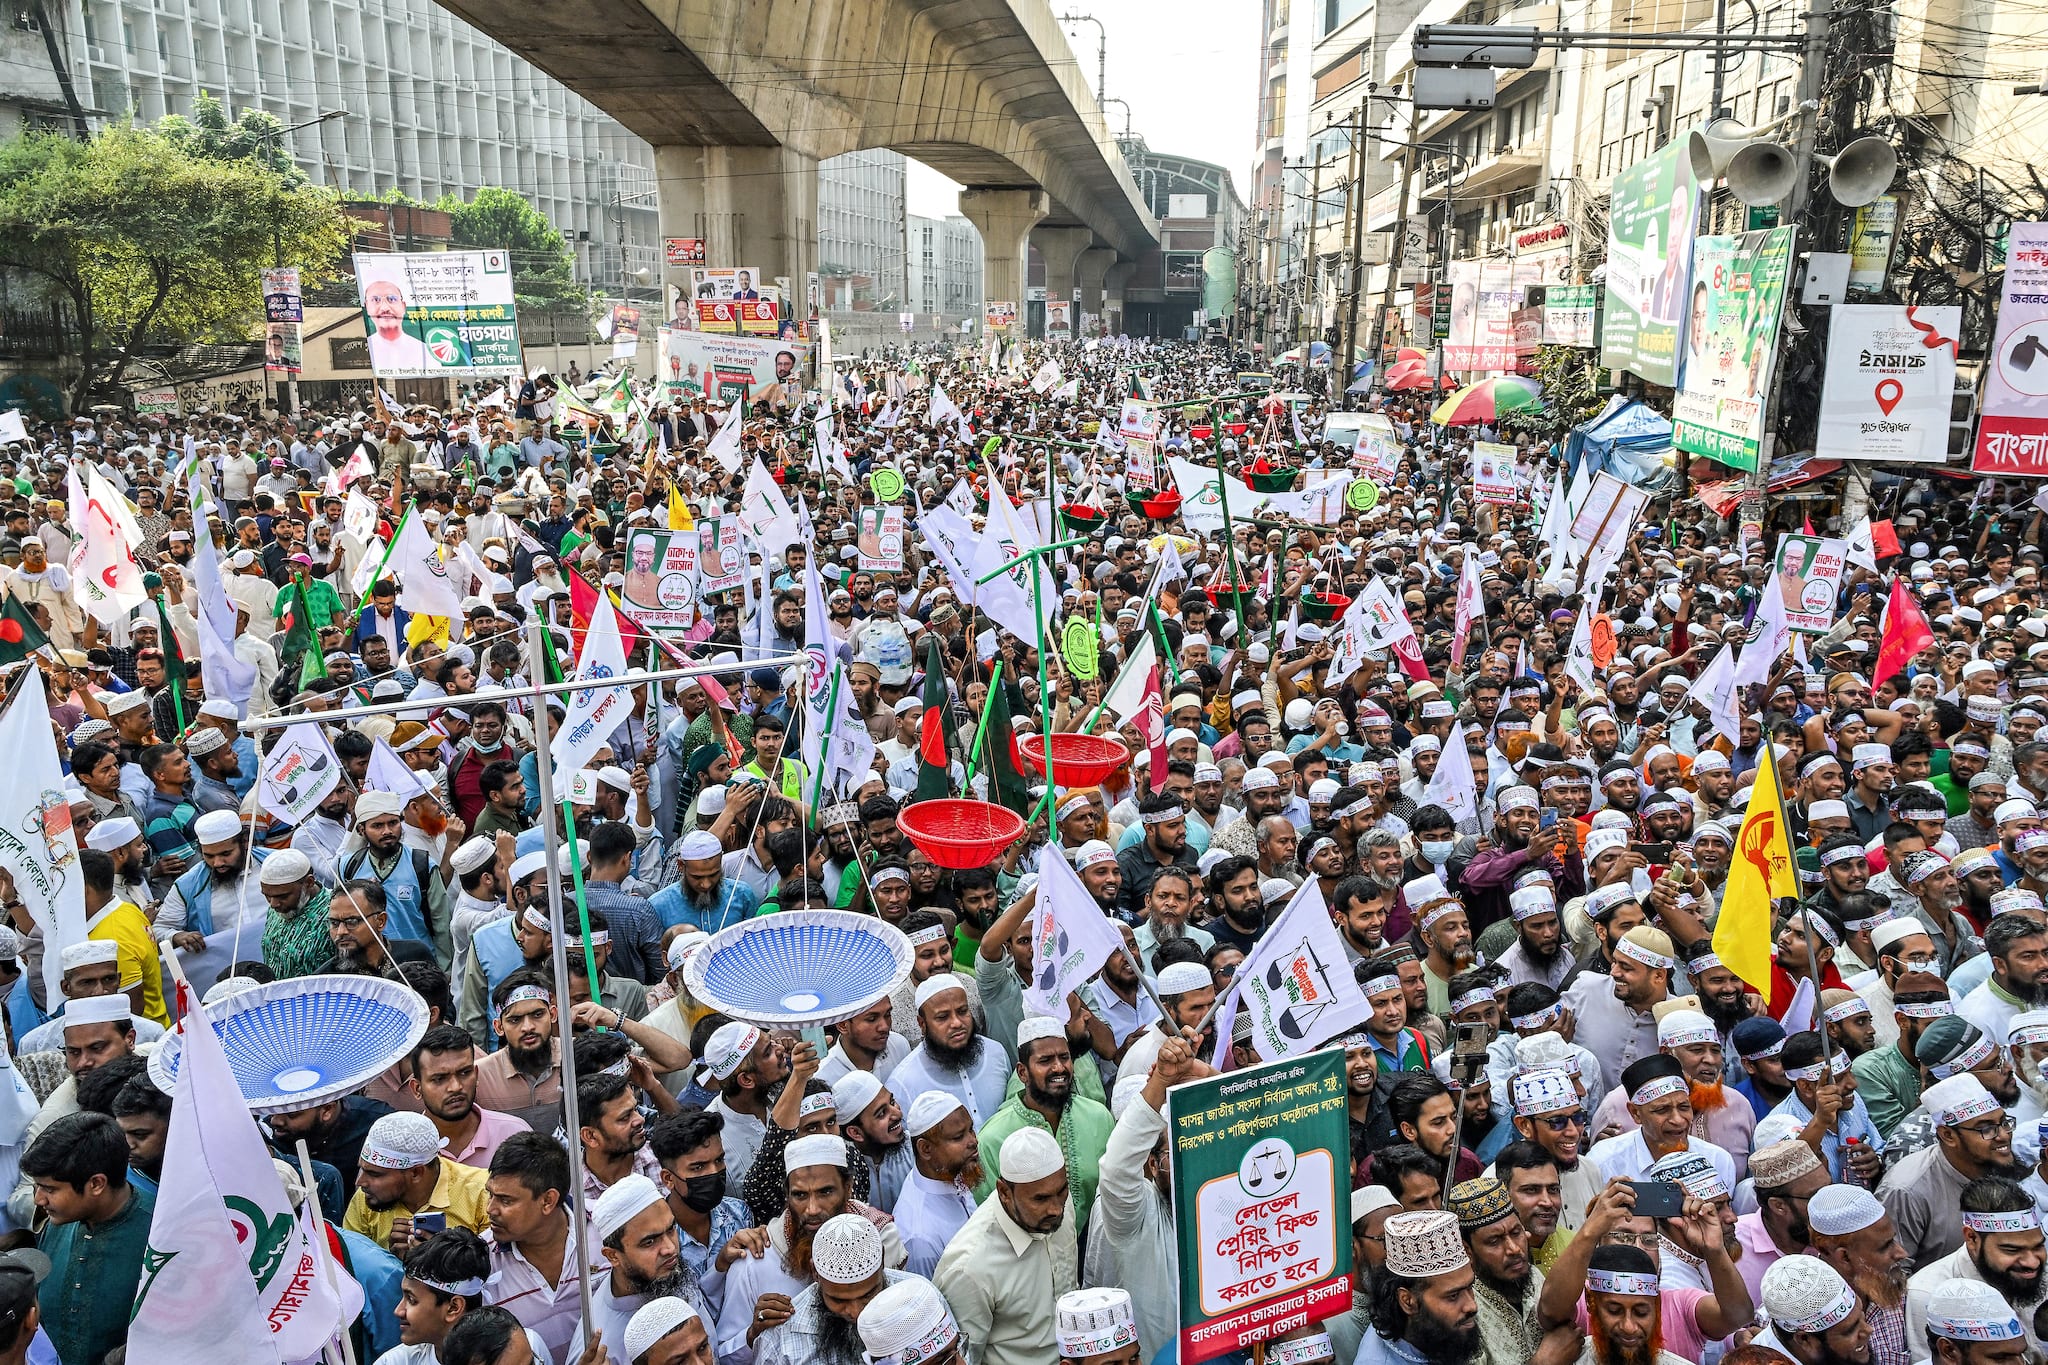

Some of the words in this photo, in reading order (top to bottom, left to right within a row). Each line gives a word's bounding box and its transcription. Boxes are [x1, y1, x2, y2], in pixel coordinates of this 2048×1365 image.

[443, 266, 475, 277] আসনে
[410, 293, 432, 303] সংসদ
[435, 292, 458, 302] সদস্য
[458, 326, 514, 343] হাতপাখা
[472, 355, 494, 365] ভোট
[498, 354, 517, 364] দিন
[1220, 1077, 1258, 1097] বিসমিল্লাহির
[1259, 1071, 1287, 1089] রহমানির
[1289, 1067, 1305, 1083] রহিম
[1179, 1113, 1205, 1128] আসন্ন
[1207, 1106, 1234, 1121] জাতীয়
[1237, 1099, 1262, 1113] সংসদ
[1264, 1089, 1294, 1107] নির্বাচন
[1296, 1083, 1321, 1101] অবাধ,
[1179, 1132, 1215, 1153] নিরপেক্ষ
[1217, 1130, 1225, 1141] ও
[1227, 1114, 1280, 1139] শান্তিপূর্ণভাবে
[1281, 1104, 1320, 1126] অনুষ্ঠানের
[1235, 1191, 1301, 1226] লেভেল
[1973, 1215, 2022, 1231] জামায়াতে
[1216, 1226, 1267, 1258] প্লেয়িং
[1276, 1208, 1320, 1239] ফিল্ড
[1236, 1239, 1301, 1275] নিশ্চিত
[1218, 1271, 1278, 1304] করতে
[1284, 1256, 1320, 1283] হবে
[1190, 1311, 1249, 1344] বাংলাদেশ
[1250, 1296, 1306, 1325] জামায়াতে
[1307, 1275, 1349, 1306] ইসলামী
[1237, 1324, 1270, 1348] ঢাকা
[1272, 1311, 1308, 1337] জেলা
[1944, 1319, 2007, 1339] ইসলামী
[1064, 1337, 1111, 1356] জামায়াতে
